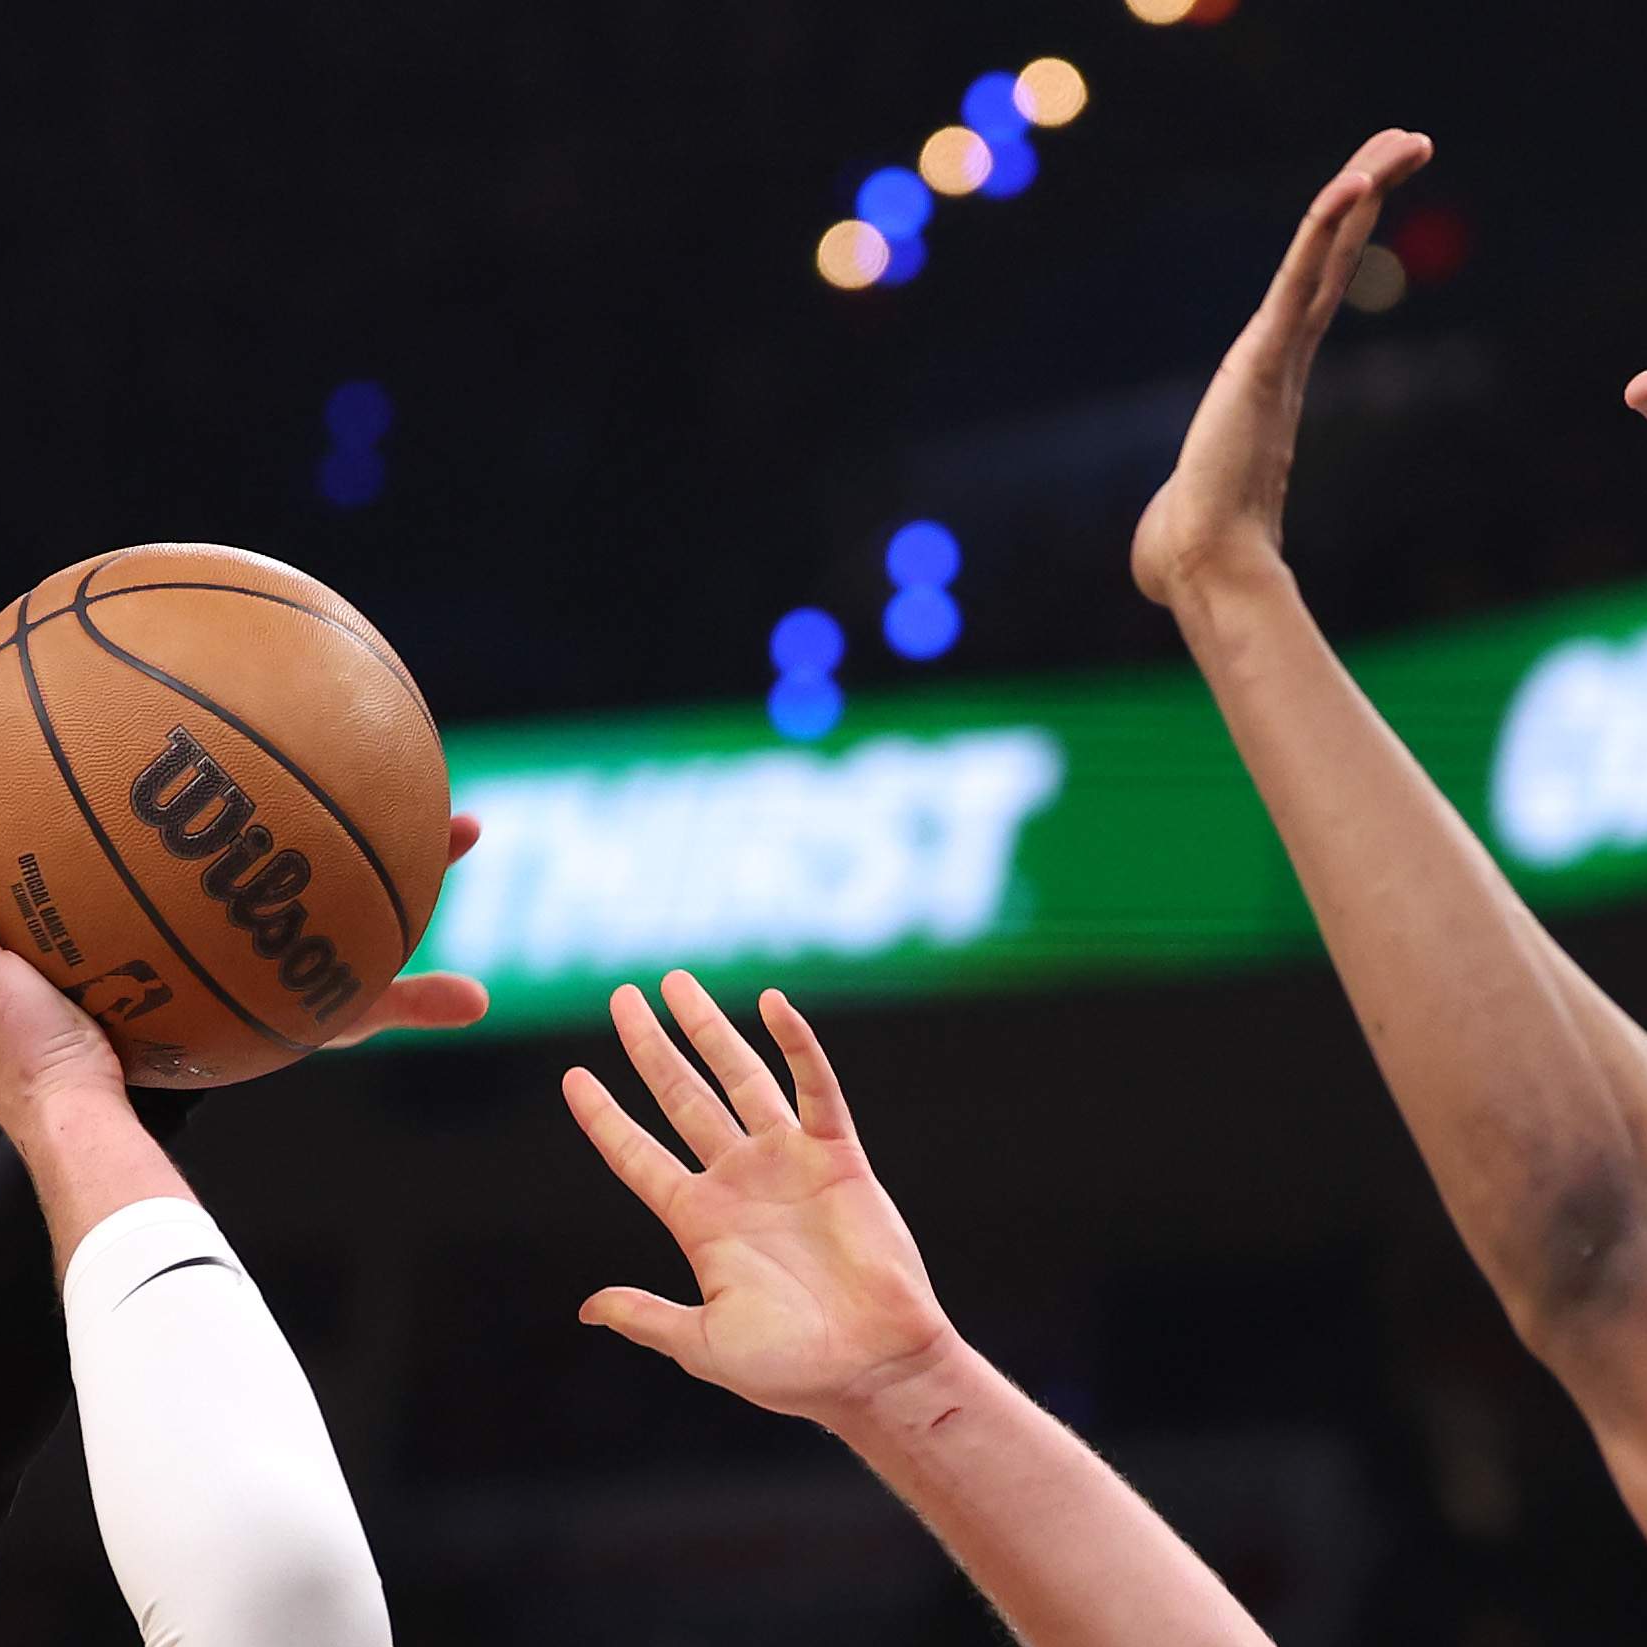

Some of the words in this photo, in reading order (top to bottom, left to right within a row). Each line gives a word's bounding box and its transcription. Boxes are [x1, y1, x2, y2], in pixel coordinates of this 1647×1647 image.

[18, 853, 51, 908] OFFICIAL
[39, 906, 68, 940] GAME
[56, 939, 85, 967] BALL
[130, 722, 362, 1025] Wilson
[436, 728, 1066, 978] THIRST
